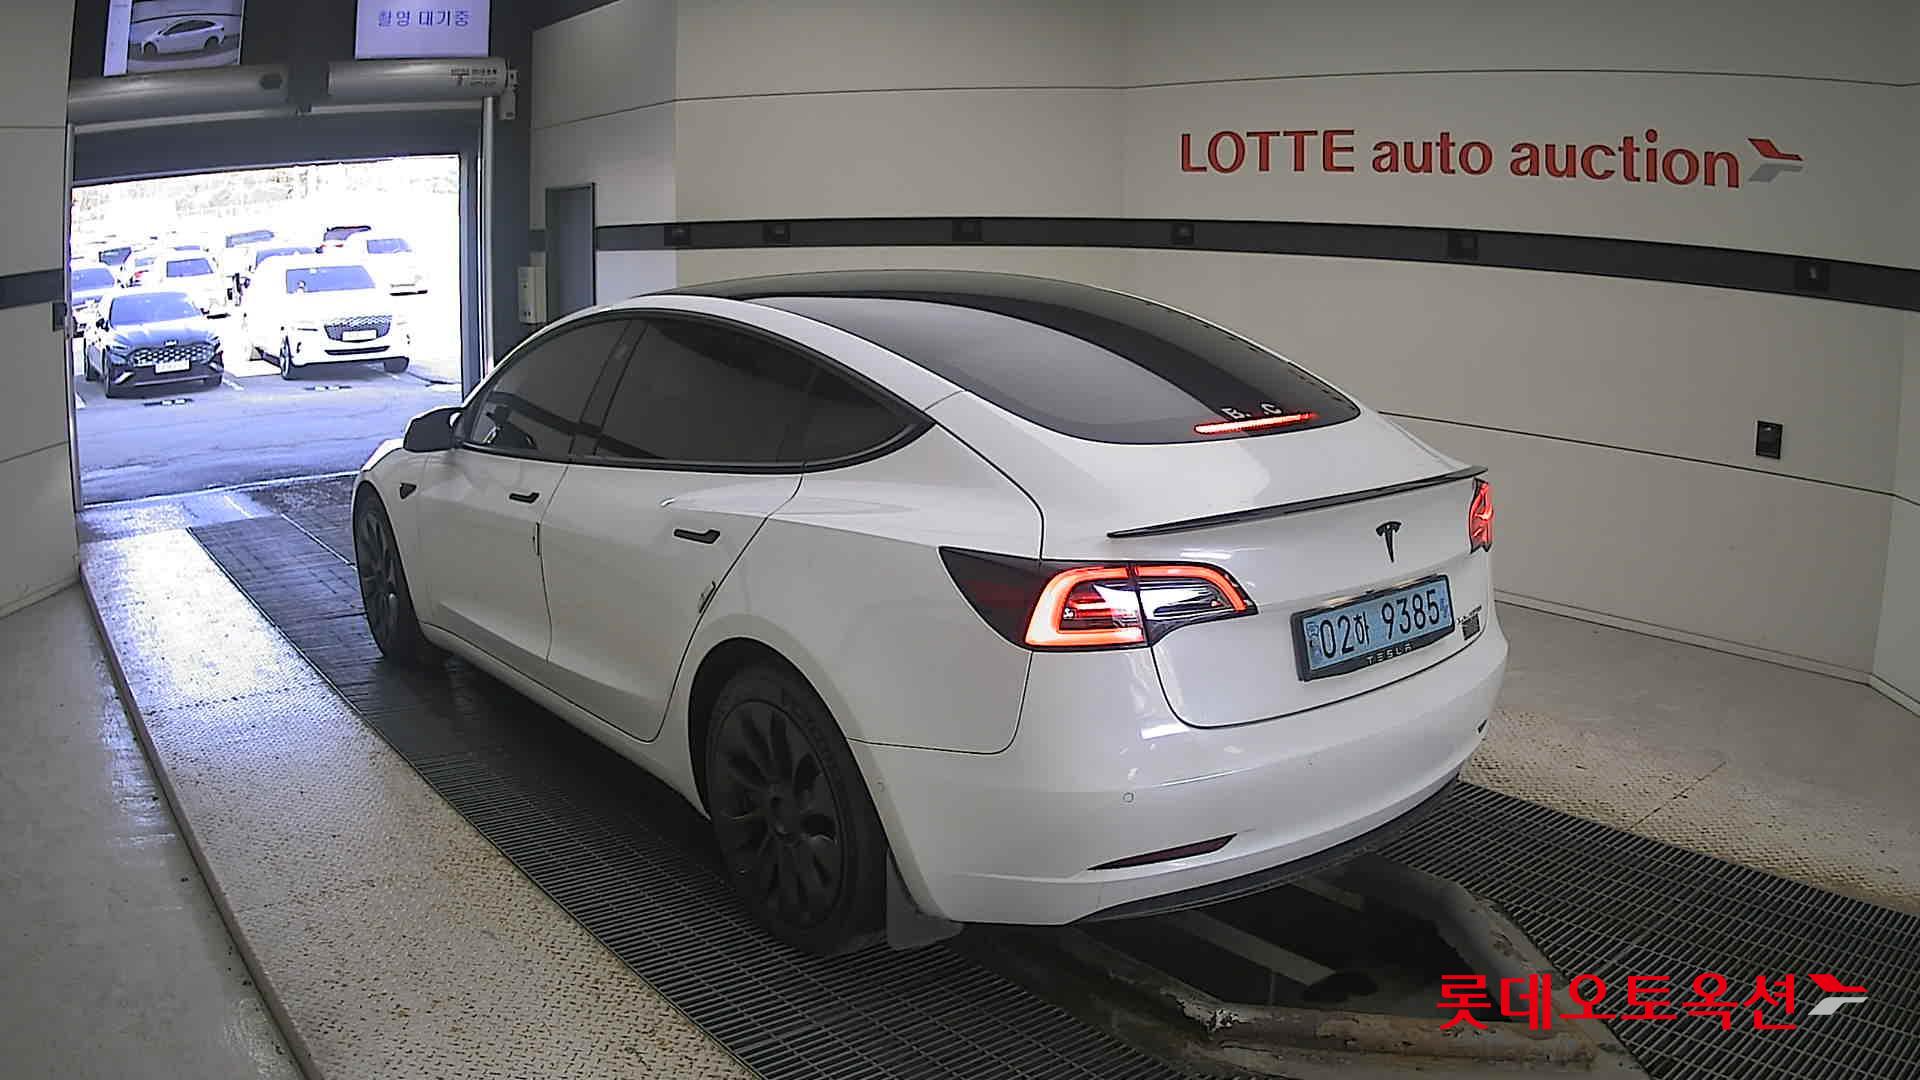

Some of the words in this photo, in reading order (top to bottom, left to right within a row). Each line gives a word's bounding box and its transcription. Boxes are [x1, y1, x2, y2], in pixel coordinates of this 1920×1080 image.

[418, 9, 471, 27] 대기중
[1181, 129, 1355, 173] LOTTE
[1372, 131, 1494, 175] auto
[1510, 129, 1740, 188] auction
[1319, 611, 1371, 658] 02하
[1381, 589, 1440, 641] 9385
[1367, 643, 1413, 665] TESLA
